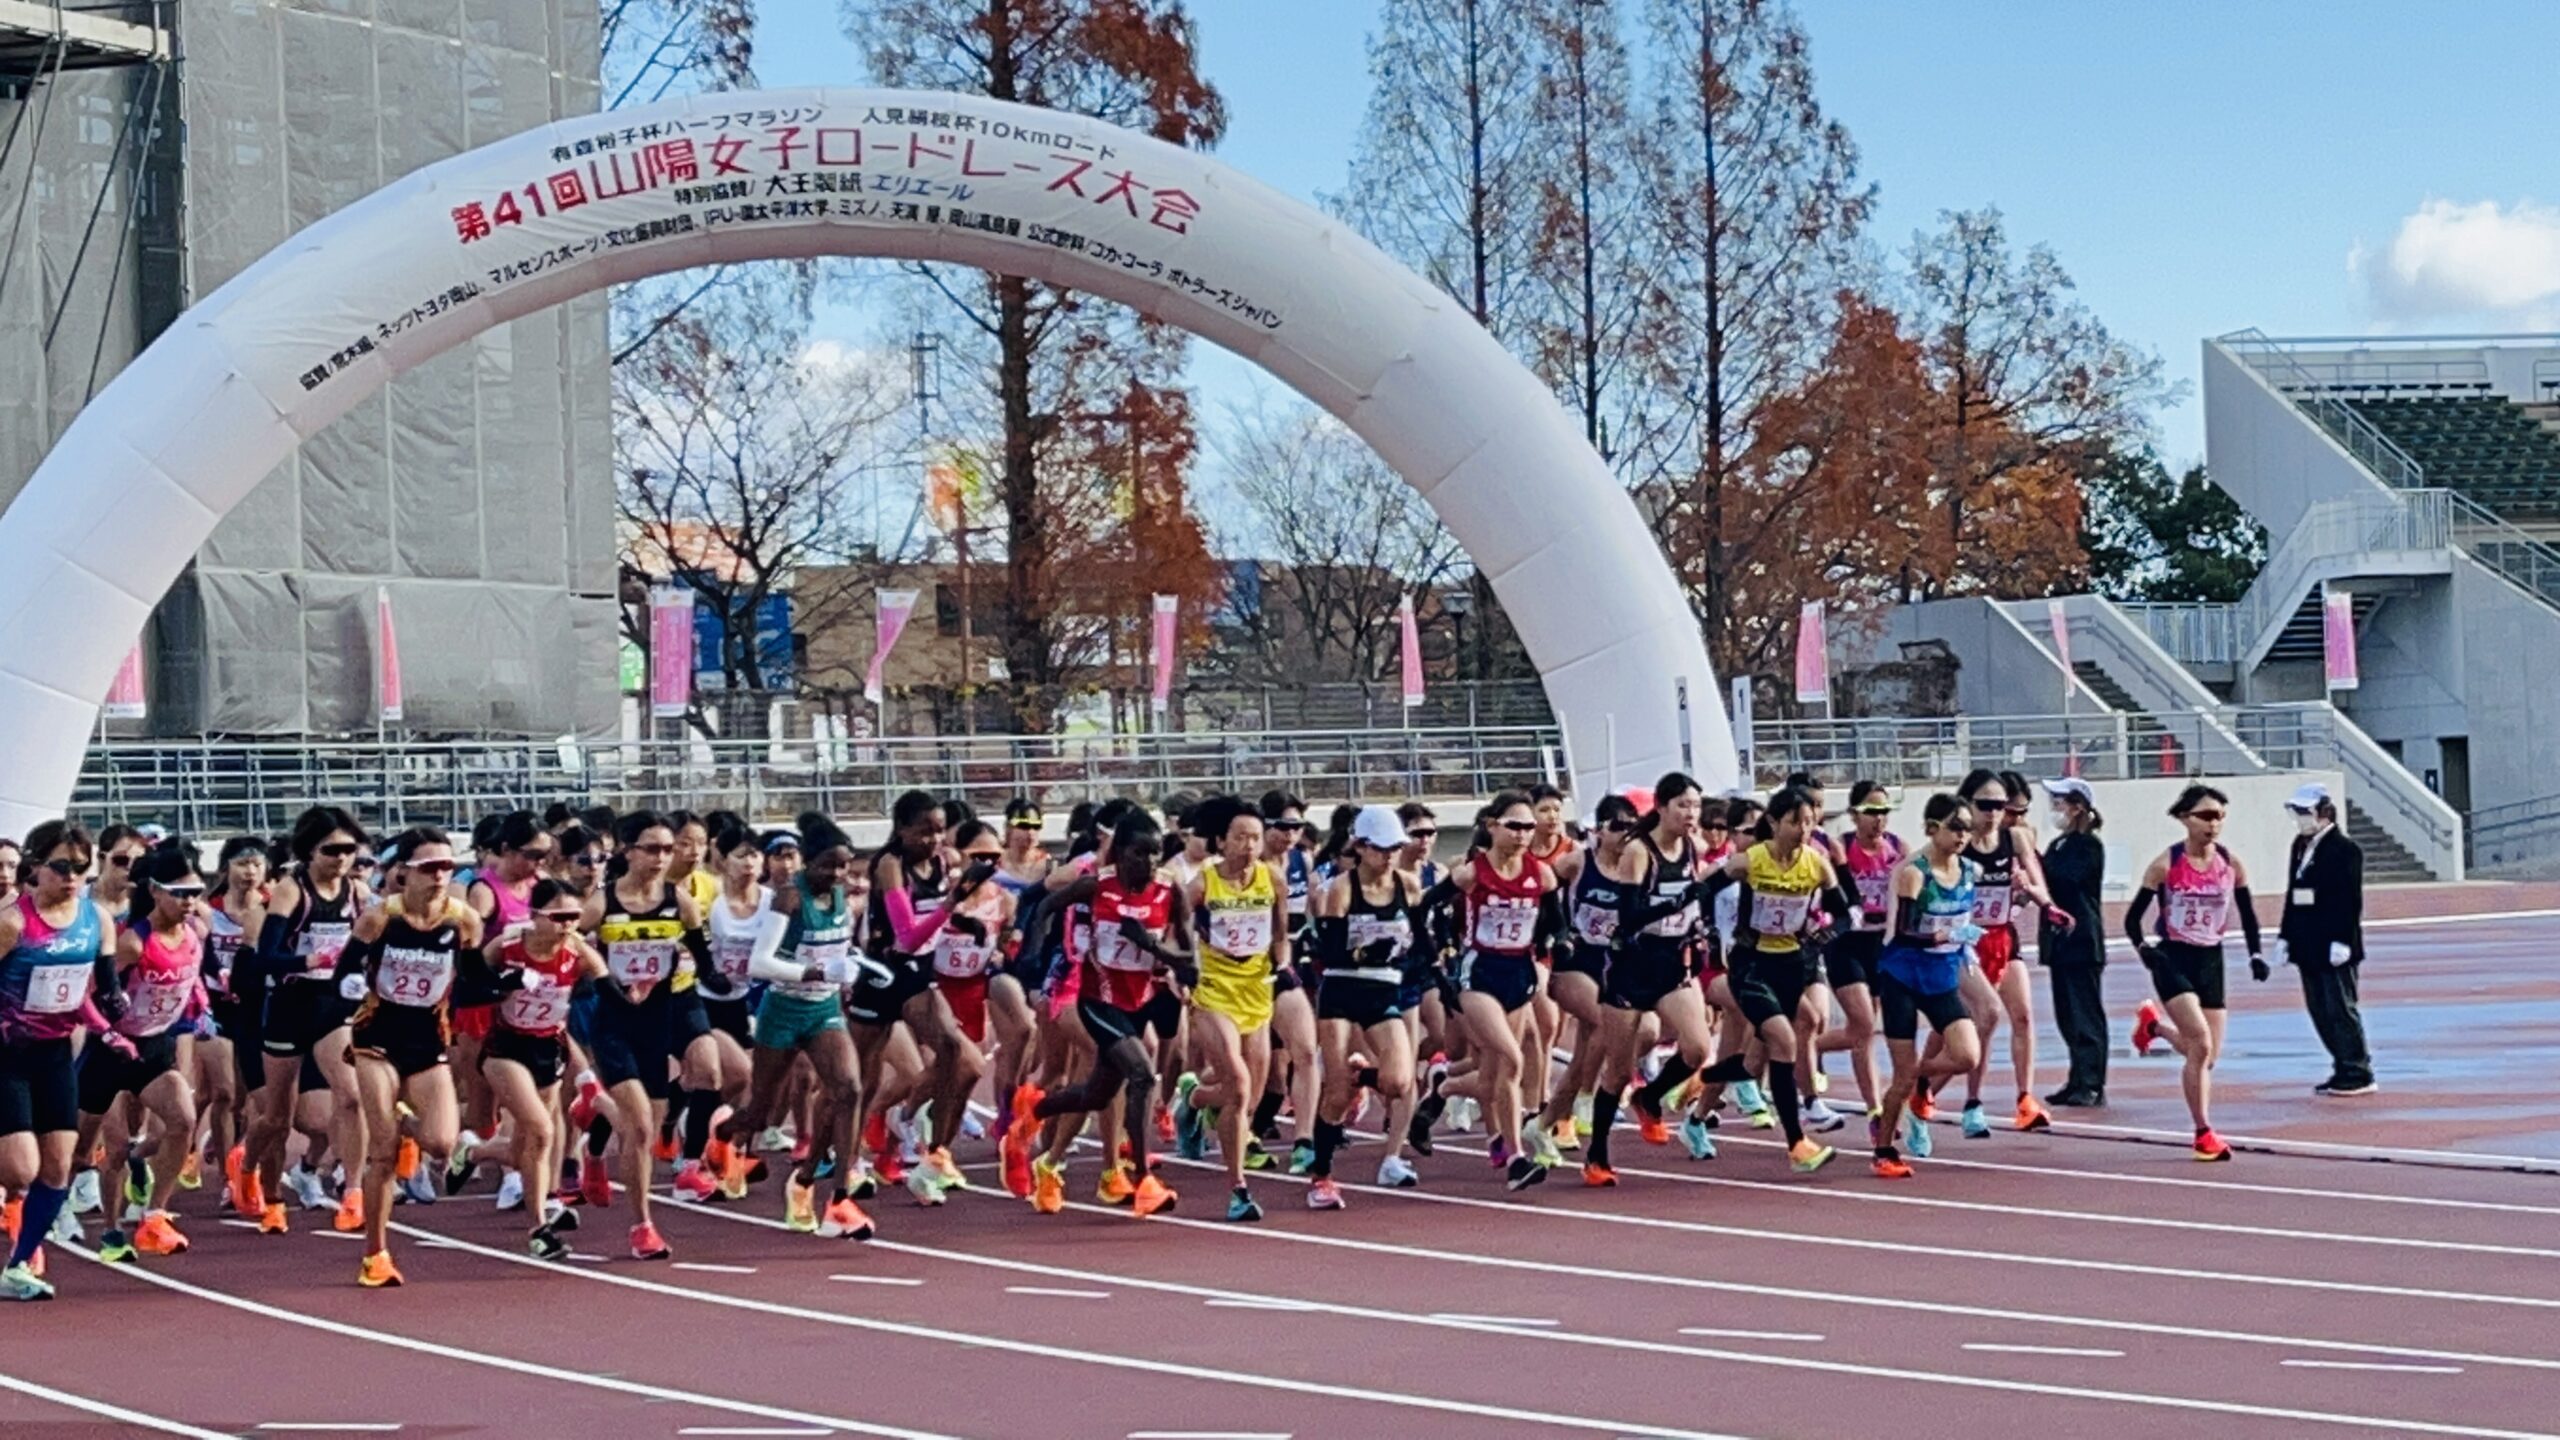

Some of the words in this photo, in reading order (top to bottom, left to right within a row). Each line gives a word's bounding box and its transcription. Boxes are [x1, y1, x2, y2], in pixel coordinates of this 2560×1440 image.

[451, 125, 1201, 244] 第41回山陽女子ロードレース大会
[56, 983, 69, 1003] 9
[394, 975, 431, 999] 29
[515, 1000, 552, 1021] 72
